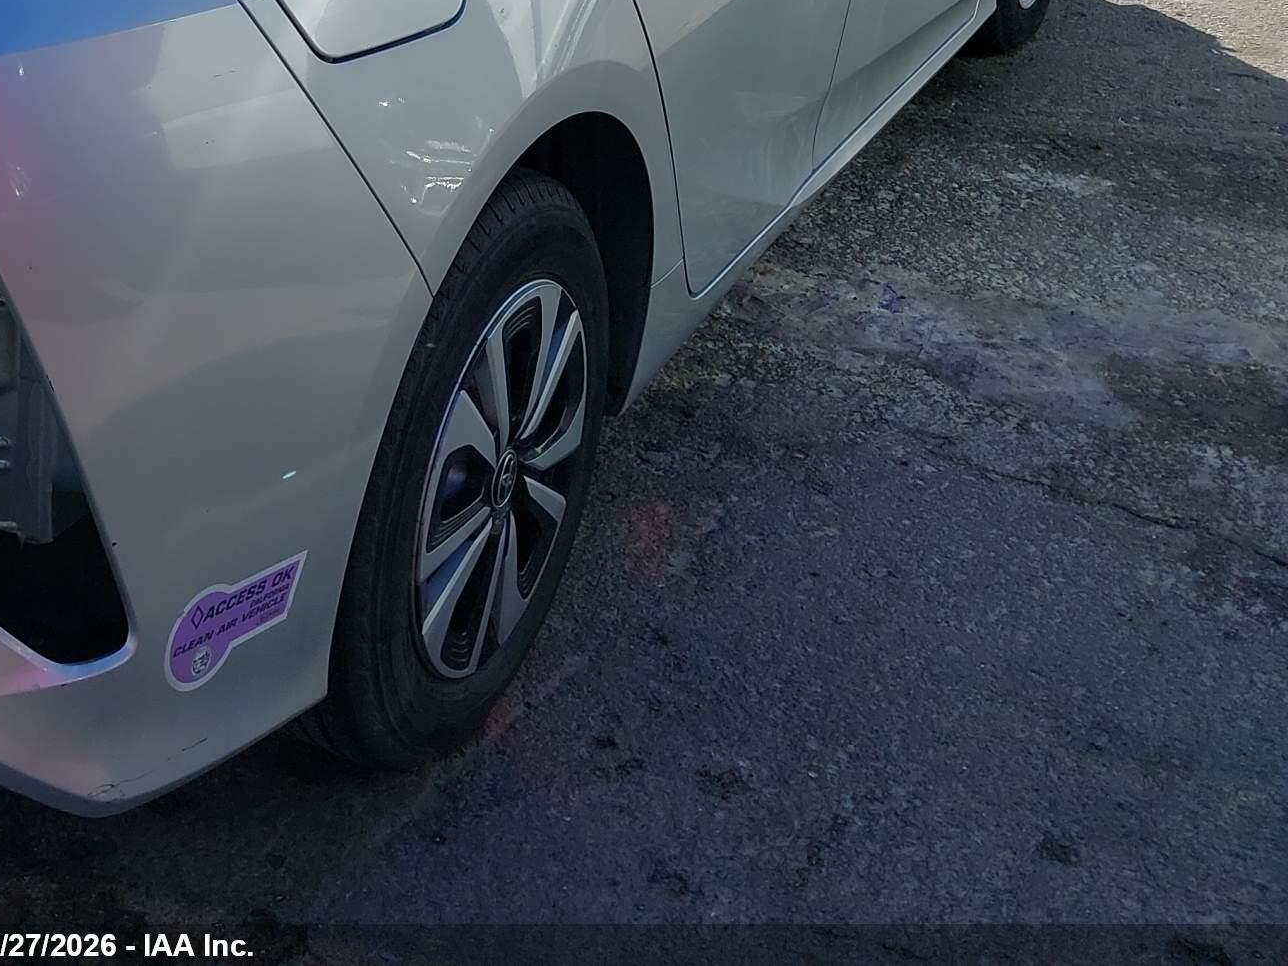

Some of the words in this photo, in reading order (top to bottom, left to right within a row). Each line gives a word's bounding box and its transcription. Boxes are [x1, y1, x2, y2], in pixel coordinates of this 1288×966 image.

[172, 629, 214, 658] CLEAN
[216, 617, 239, 636] AIR
[242, 592, 287, 623] VEHICLE
[203, 579, 268, 623] ACCESS
[271, 565, 295, 588] OK
